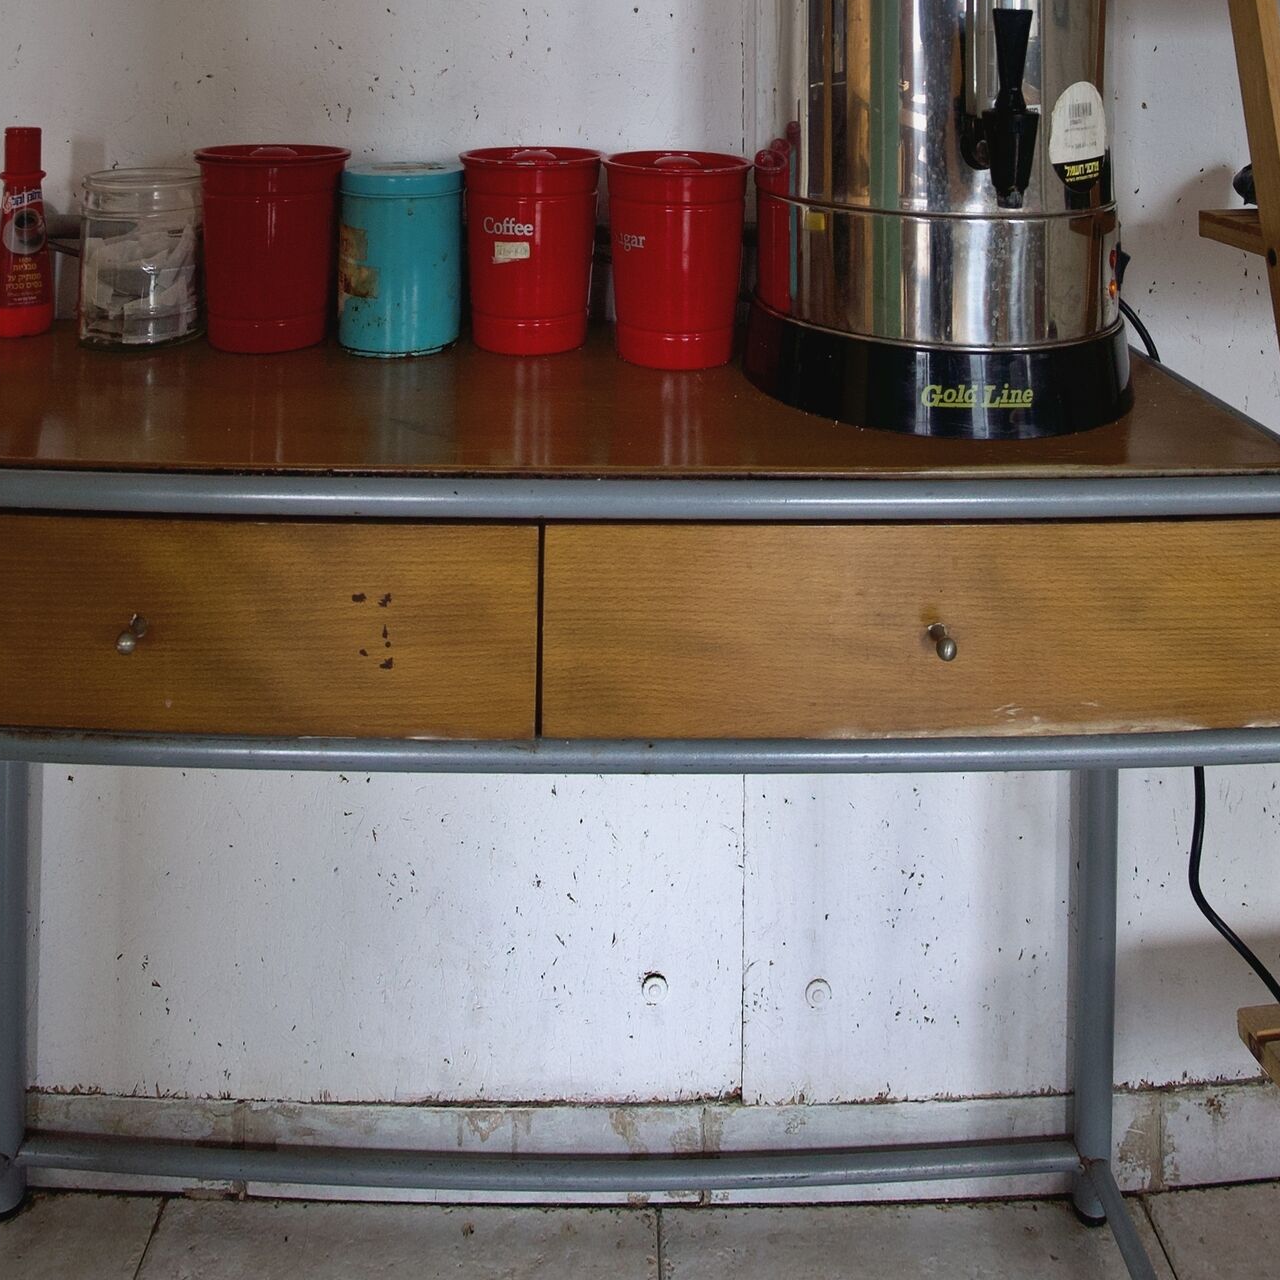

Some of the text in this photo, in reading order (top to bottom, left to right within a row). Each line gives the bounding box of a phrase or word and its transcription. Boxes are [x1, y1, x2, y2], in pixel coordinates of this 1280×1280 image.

[483, 216, 534, 236] Coffee
[920, 384, 1034, 408] Gold Line
